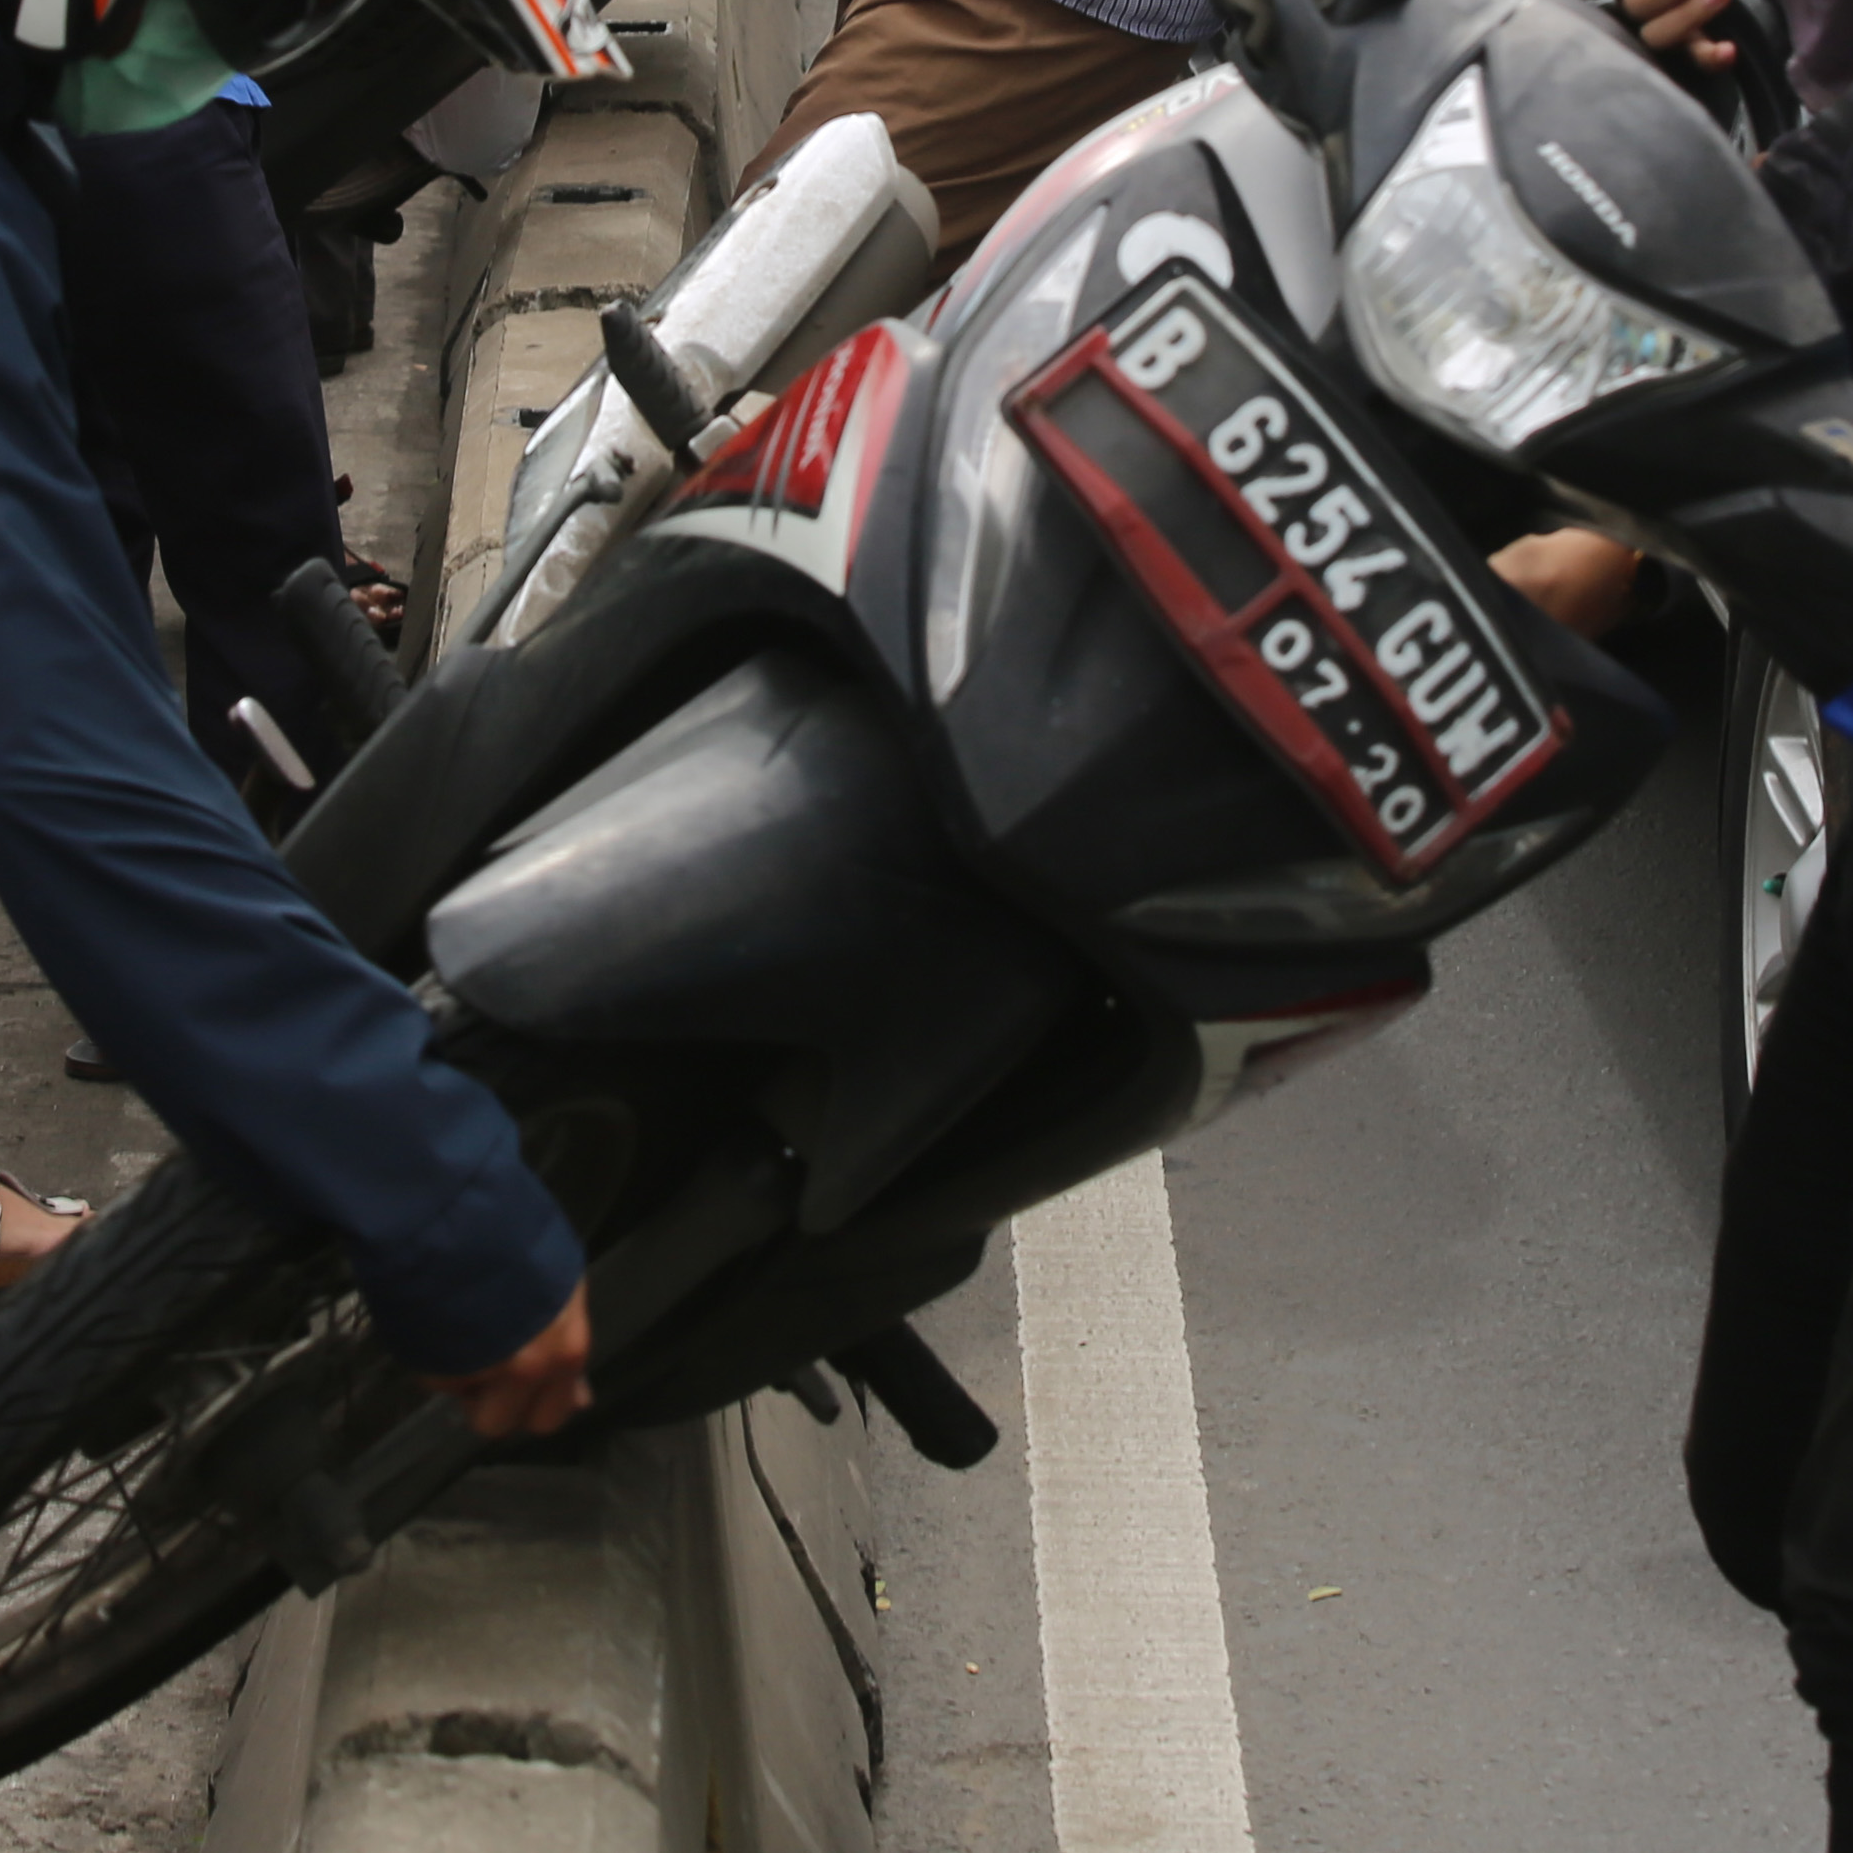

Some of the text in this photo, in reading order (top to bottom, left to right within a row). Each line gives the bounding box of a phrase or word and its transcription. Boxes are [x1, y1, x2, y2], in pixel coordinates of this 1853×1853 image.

[1537, 141, 1637, 249] HONDA
[1117, 306, 1206, 389] B
[1208, 395, 1408, 611] 6254
